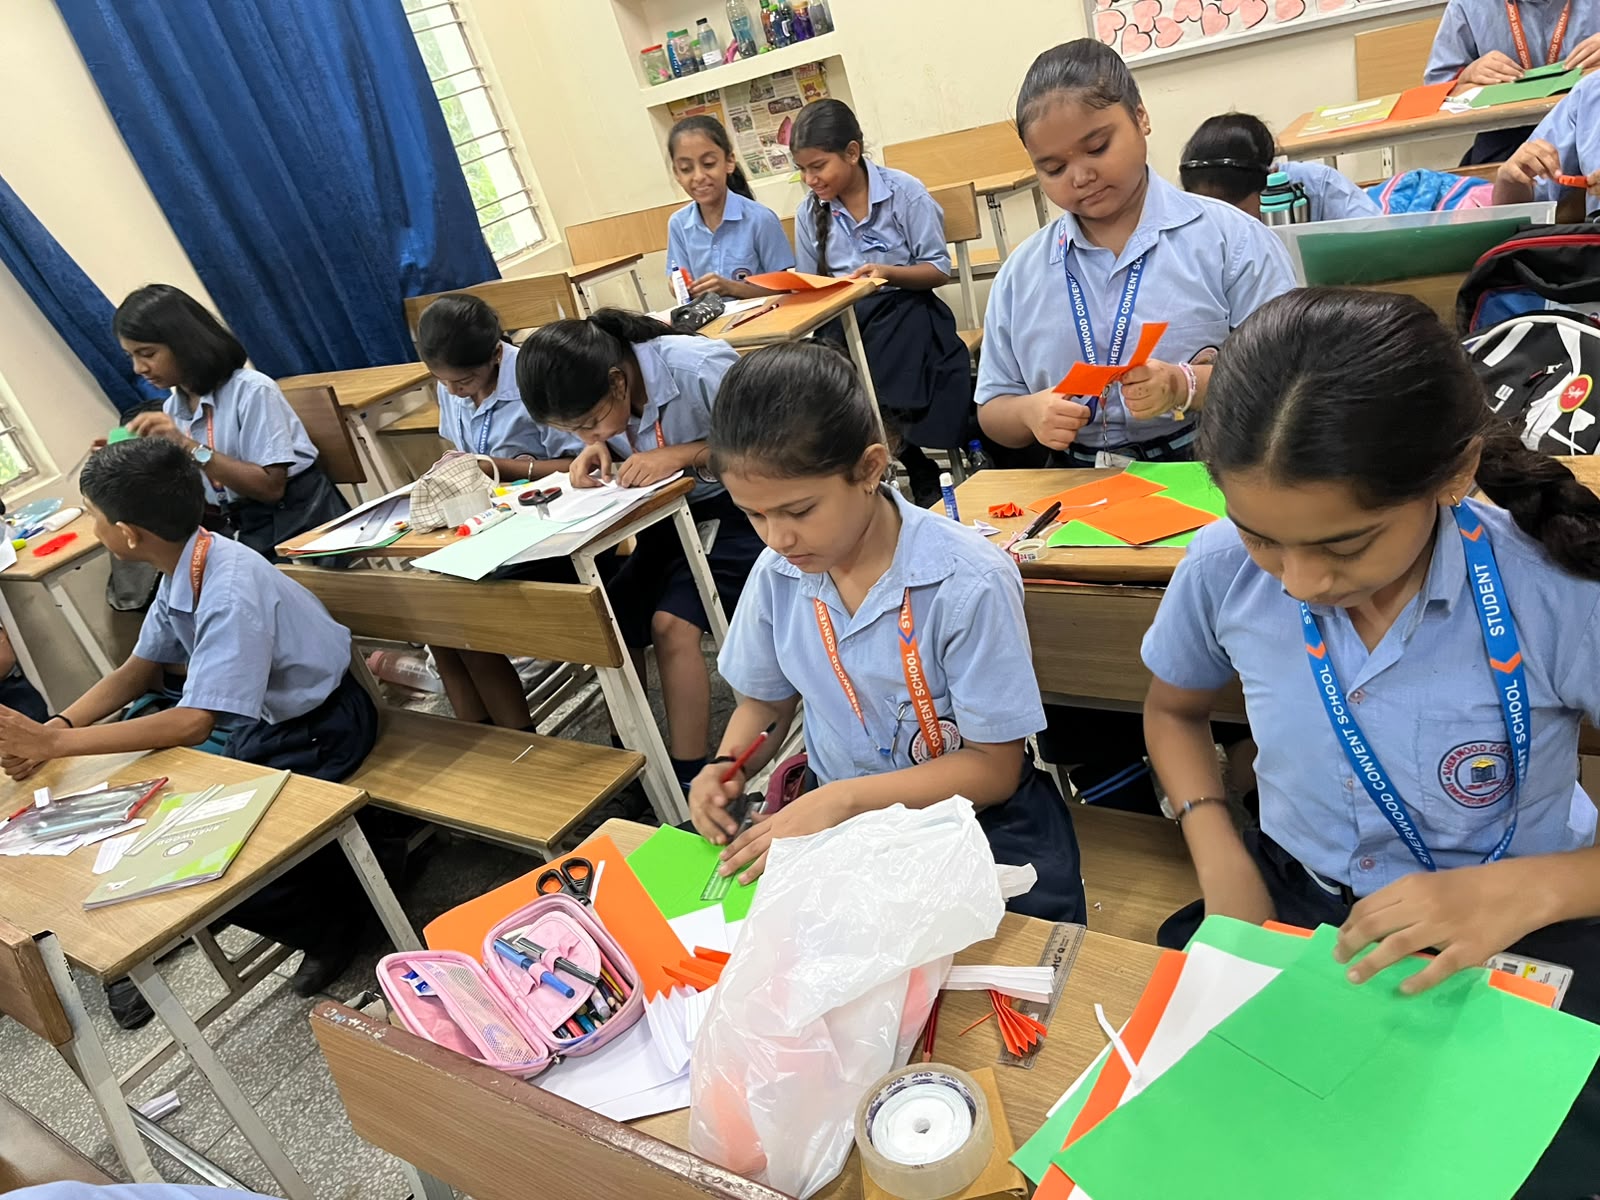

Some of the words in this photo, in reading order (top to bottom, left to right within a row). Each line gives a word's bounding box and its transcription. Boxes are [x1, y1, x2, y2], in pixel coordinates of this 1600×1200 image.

[1121, 272, 1139, 315] CONVENT
[815, 600, 835, 652] CONVENT
[1474, 563, 1505, 636] STUDENT
[906, 650, 926, 697] SCHOOL
[1319, 664, 1349, 725] SCHOOL
[917, 699, 940, 747] CONVENT
[1504, 679, 1527, 744] SCHOOL
[1342, 728, 1386, 790] CONVENT
[1380, 793, 1430, 865] SHERWOOD
